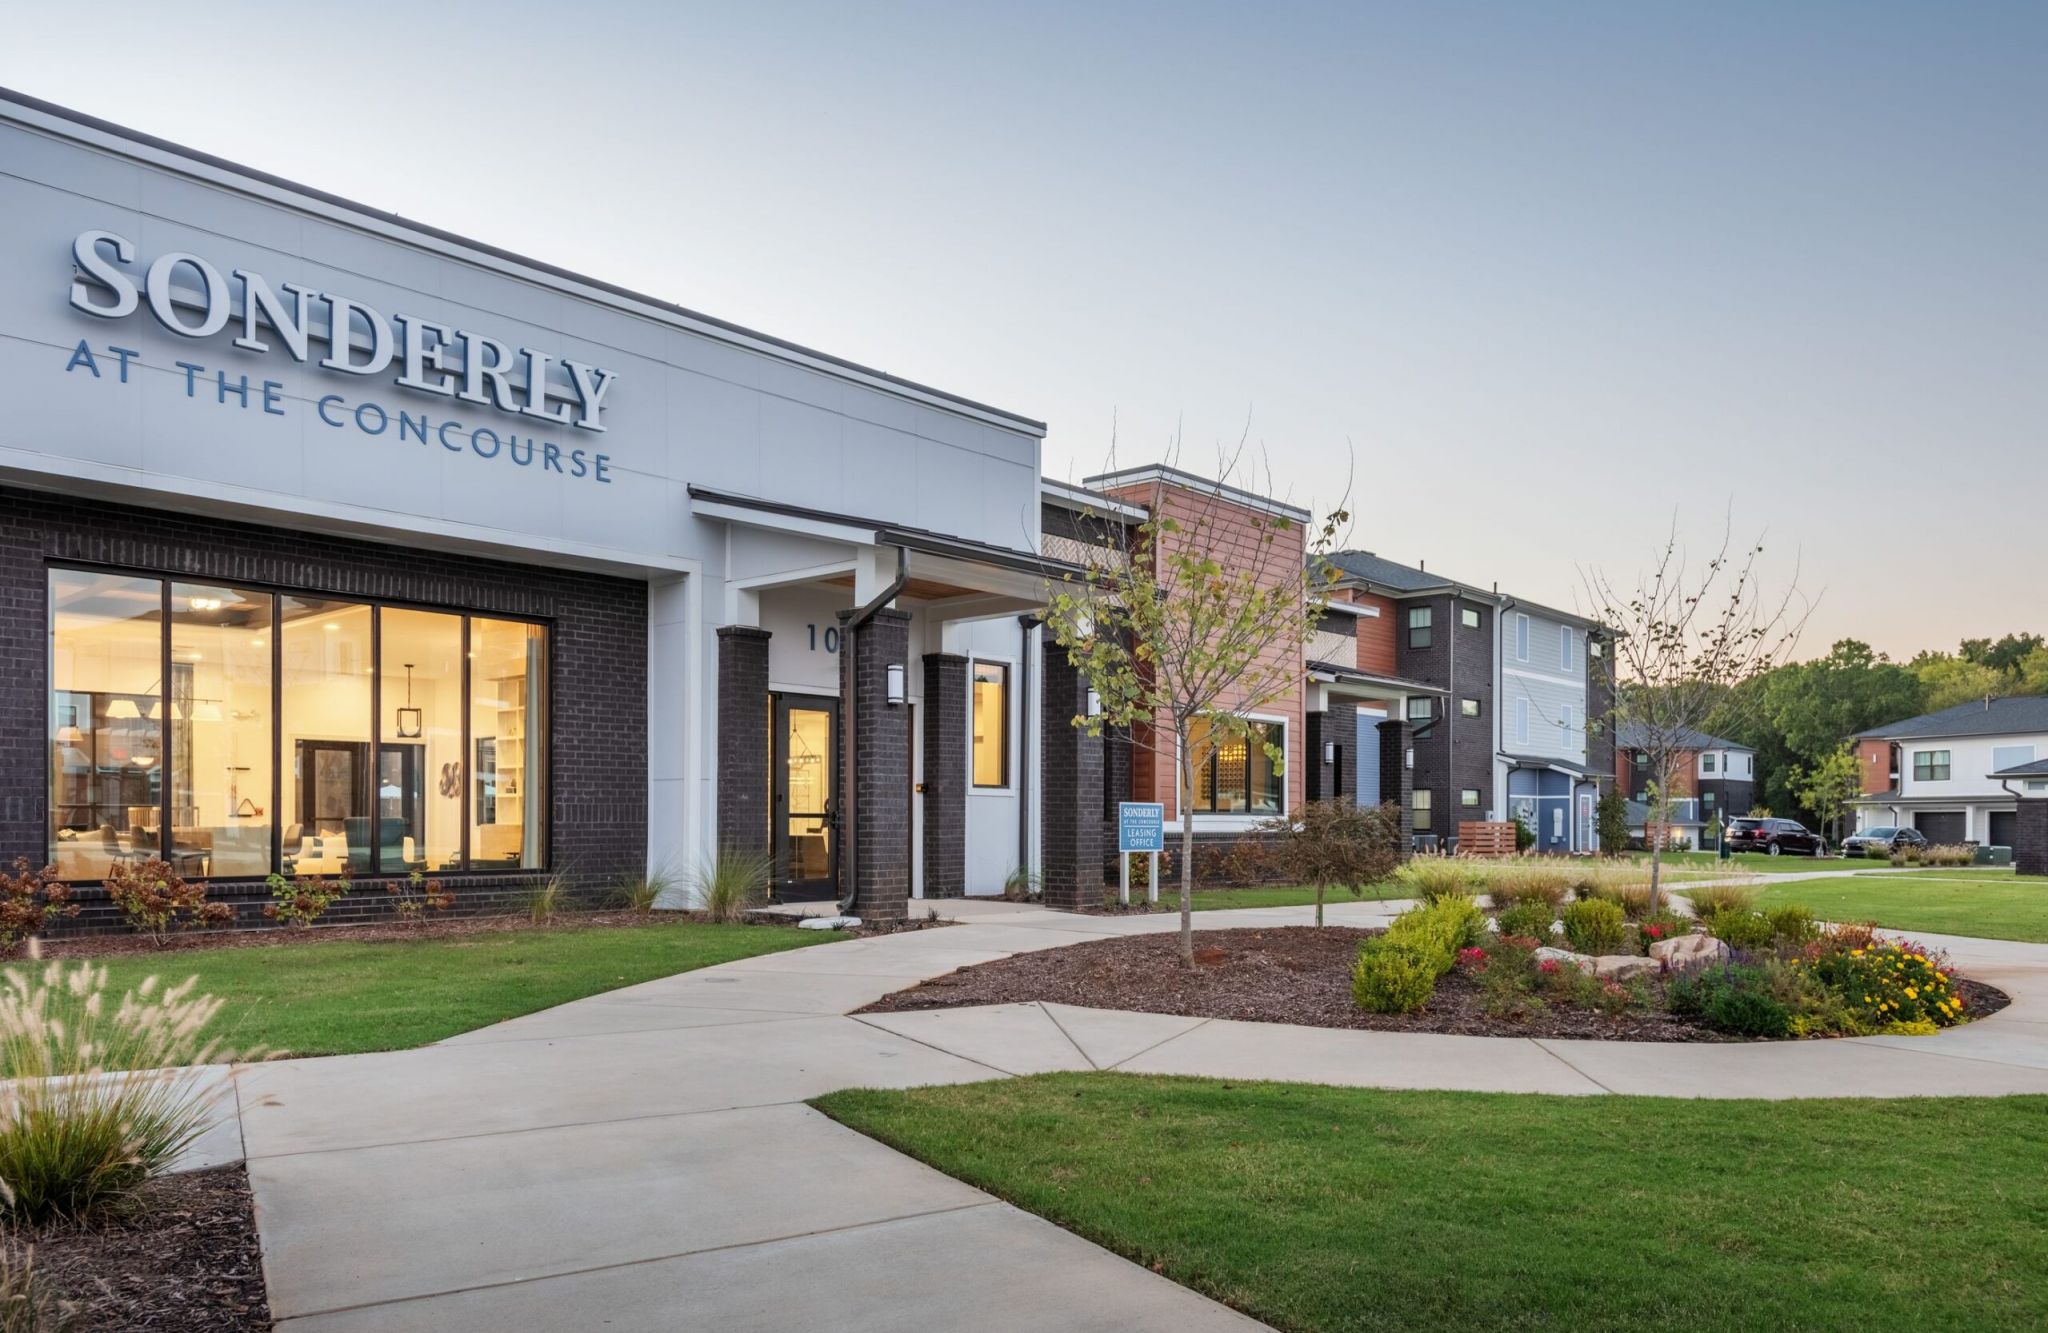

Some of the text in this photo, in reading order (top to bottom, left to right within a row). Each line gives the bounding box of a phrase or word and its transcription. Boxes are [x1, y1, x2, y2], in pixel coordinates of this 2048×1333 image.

[70, 229, 619, 432] SONDERLY
[66, 339, 612, 483] AT THE CONCOURSE
[1123, 807, 1160, 817] SONDERLY
[1127, 828, 1157, 838] LEASING
[1130, 838, 1154, 847] OFFICE
